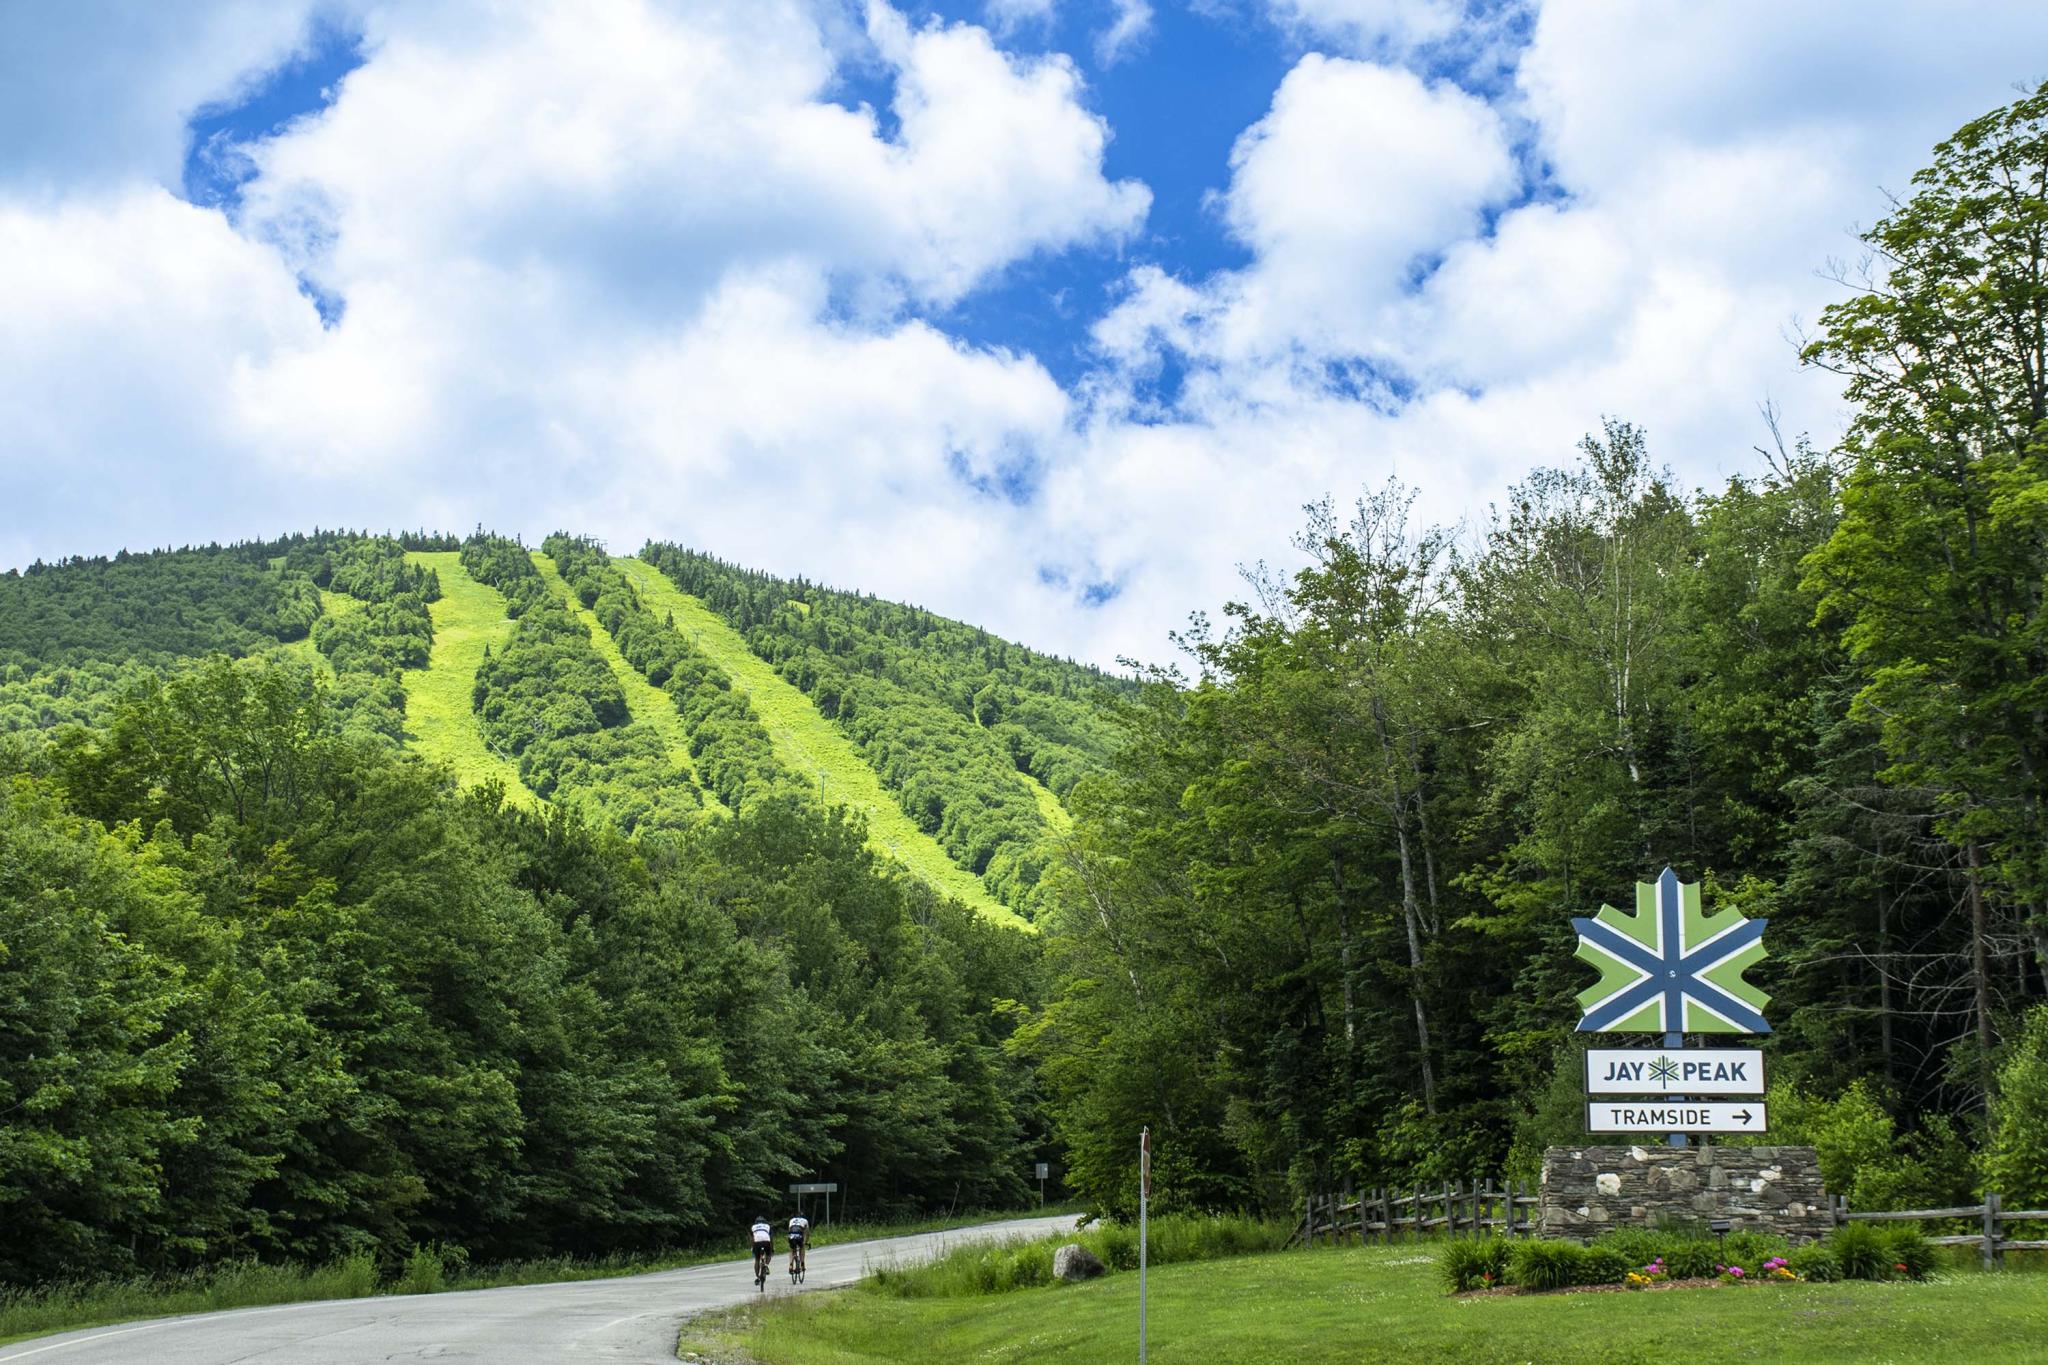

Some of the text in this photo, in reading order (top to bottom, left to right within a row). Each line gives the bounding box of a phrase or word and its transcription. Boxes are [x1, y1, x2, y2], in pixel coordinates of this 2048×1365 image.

[1603, 1062, 1747, 1081] JAY PEAK
[1611, 1109, 1711, 1125] TRAMSIDE
